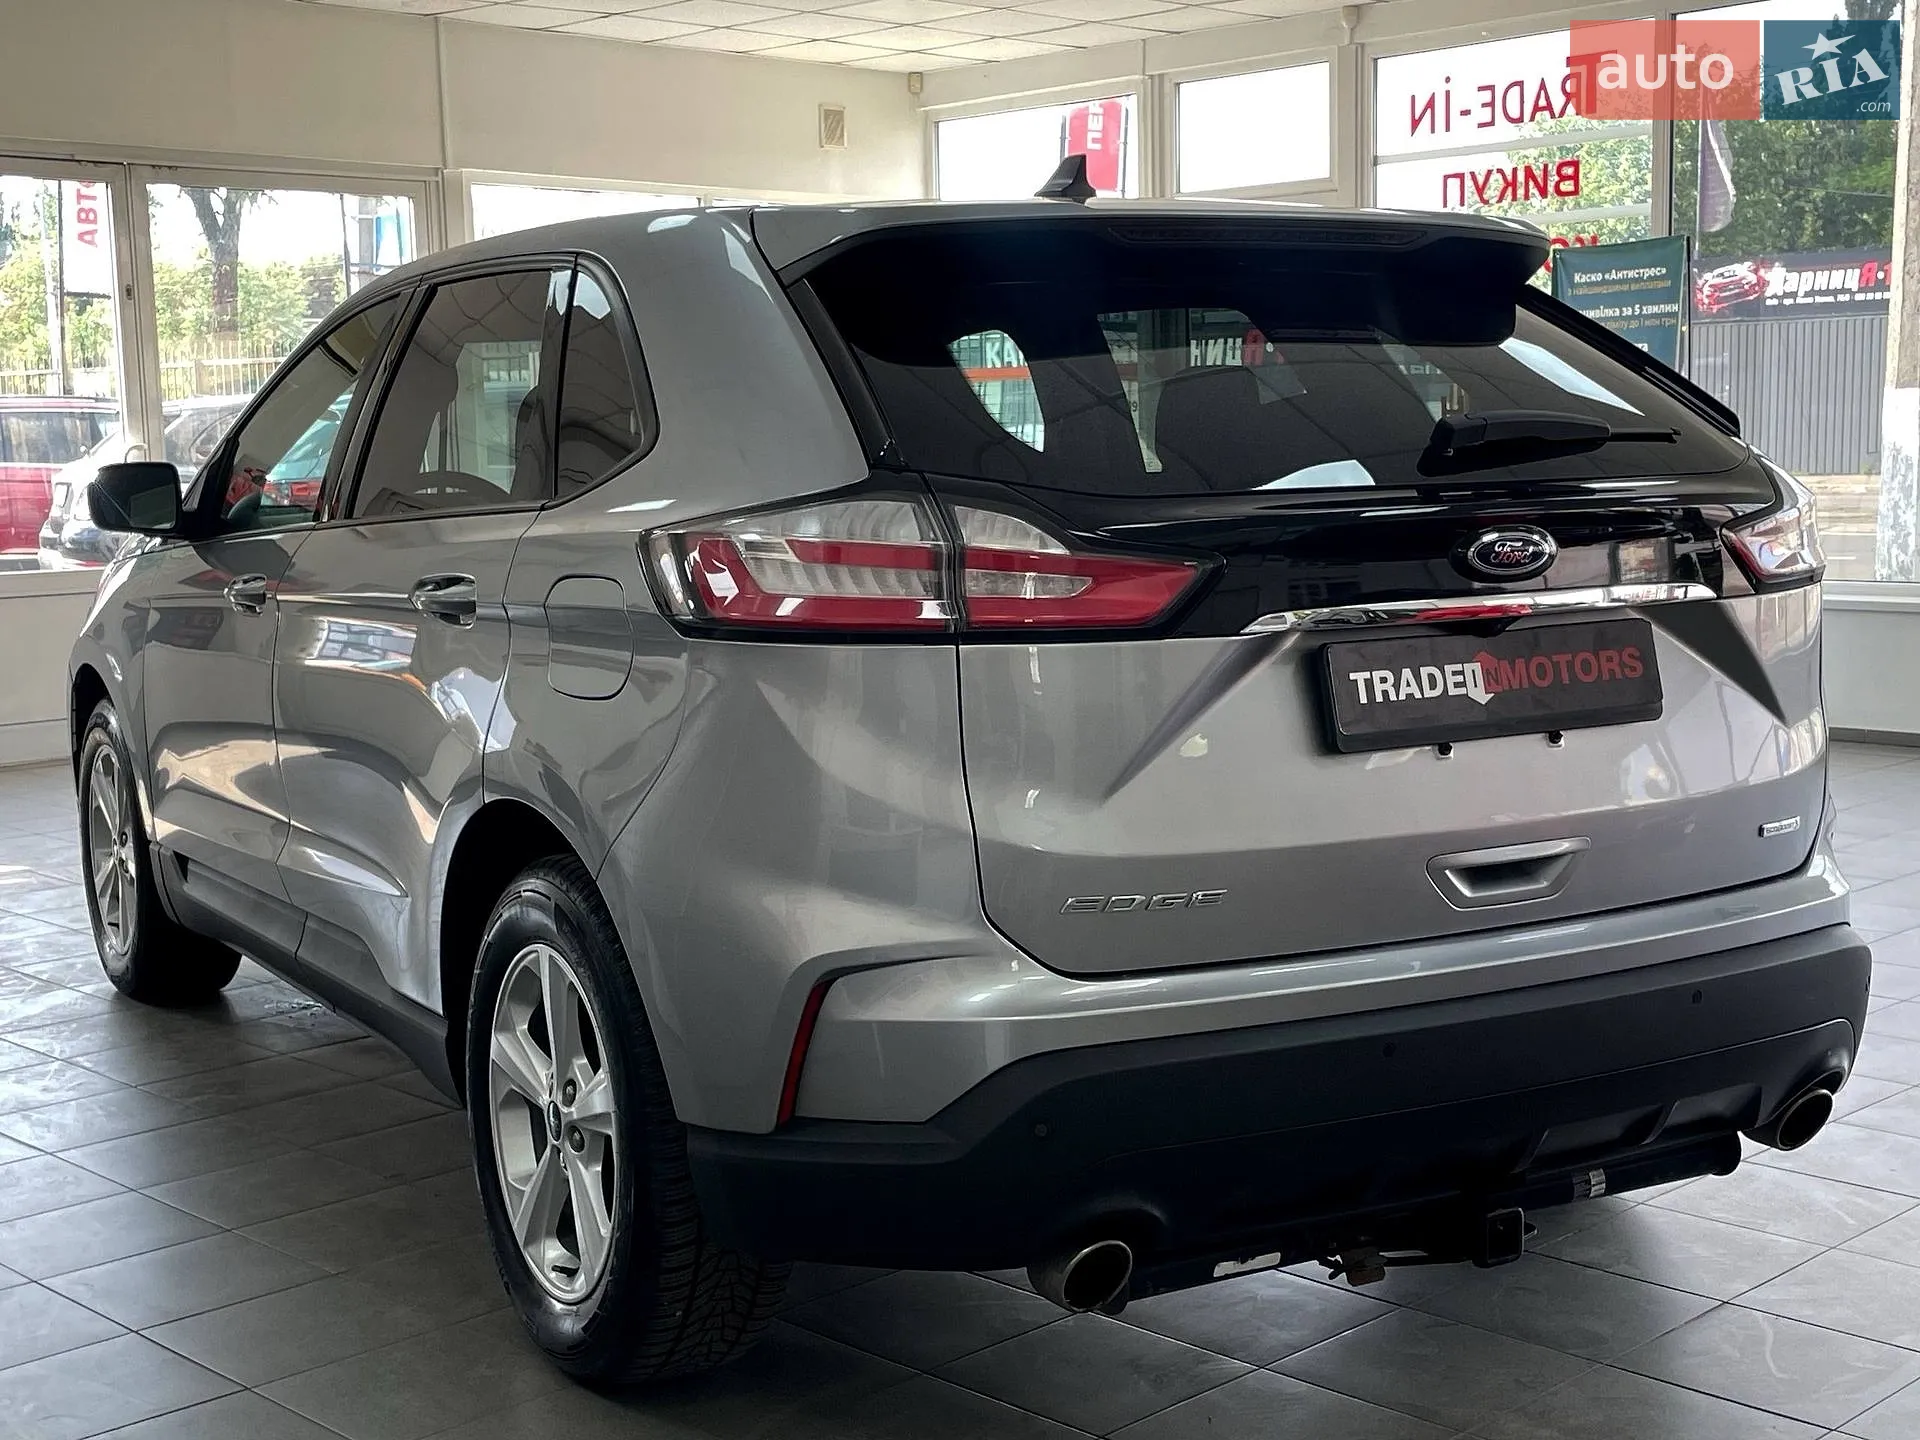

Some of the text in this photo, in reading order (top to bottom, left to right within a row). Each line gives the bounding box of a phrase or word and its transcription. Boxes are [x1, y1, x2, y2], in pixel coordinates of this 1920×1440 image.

[1574, 266, 1667, 283] Каско «Антистрес»
[1621, 307, 1632, 316] за
[1634, 305, 1641, 316] 5
[1642, 303, 1679, 315] хвилин
[1490, 541, 1533, 563] Ford
[1059, 889, 1228, 914] EDGE
